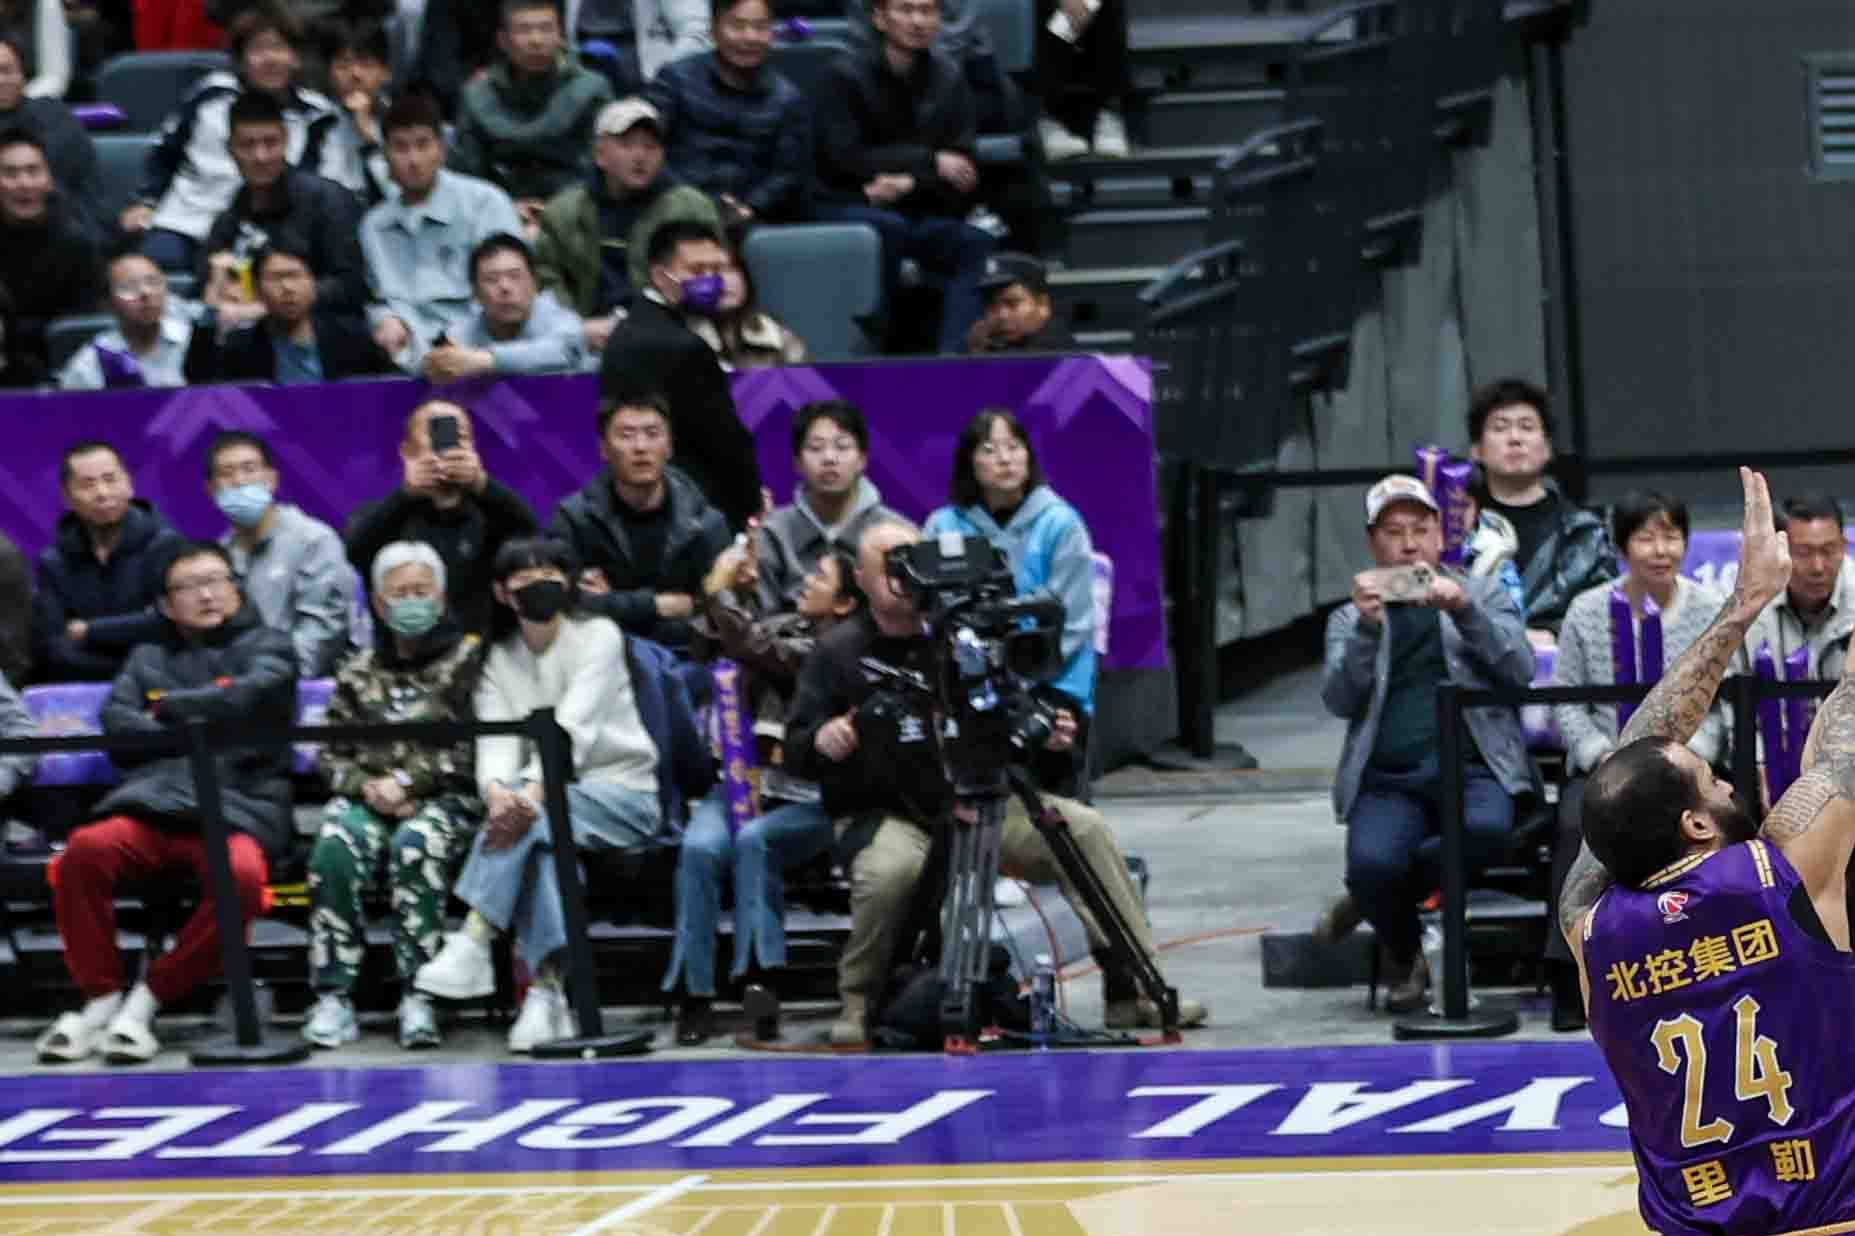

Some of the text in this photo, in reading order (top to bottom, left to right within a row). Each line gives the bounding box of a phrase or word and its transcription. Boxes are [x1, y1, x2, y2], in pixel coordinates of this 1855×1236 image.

[1605, 918, 1780, 1002] 北控集团
[1650, 993, 1795, 1148] 24
